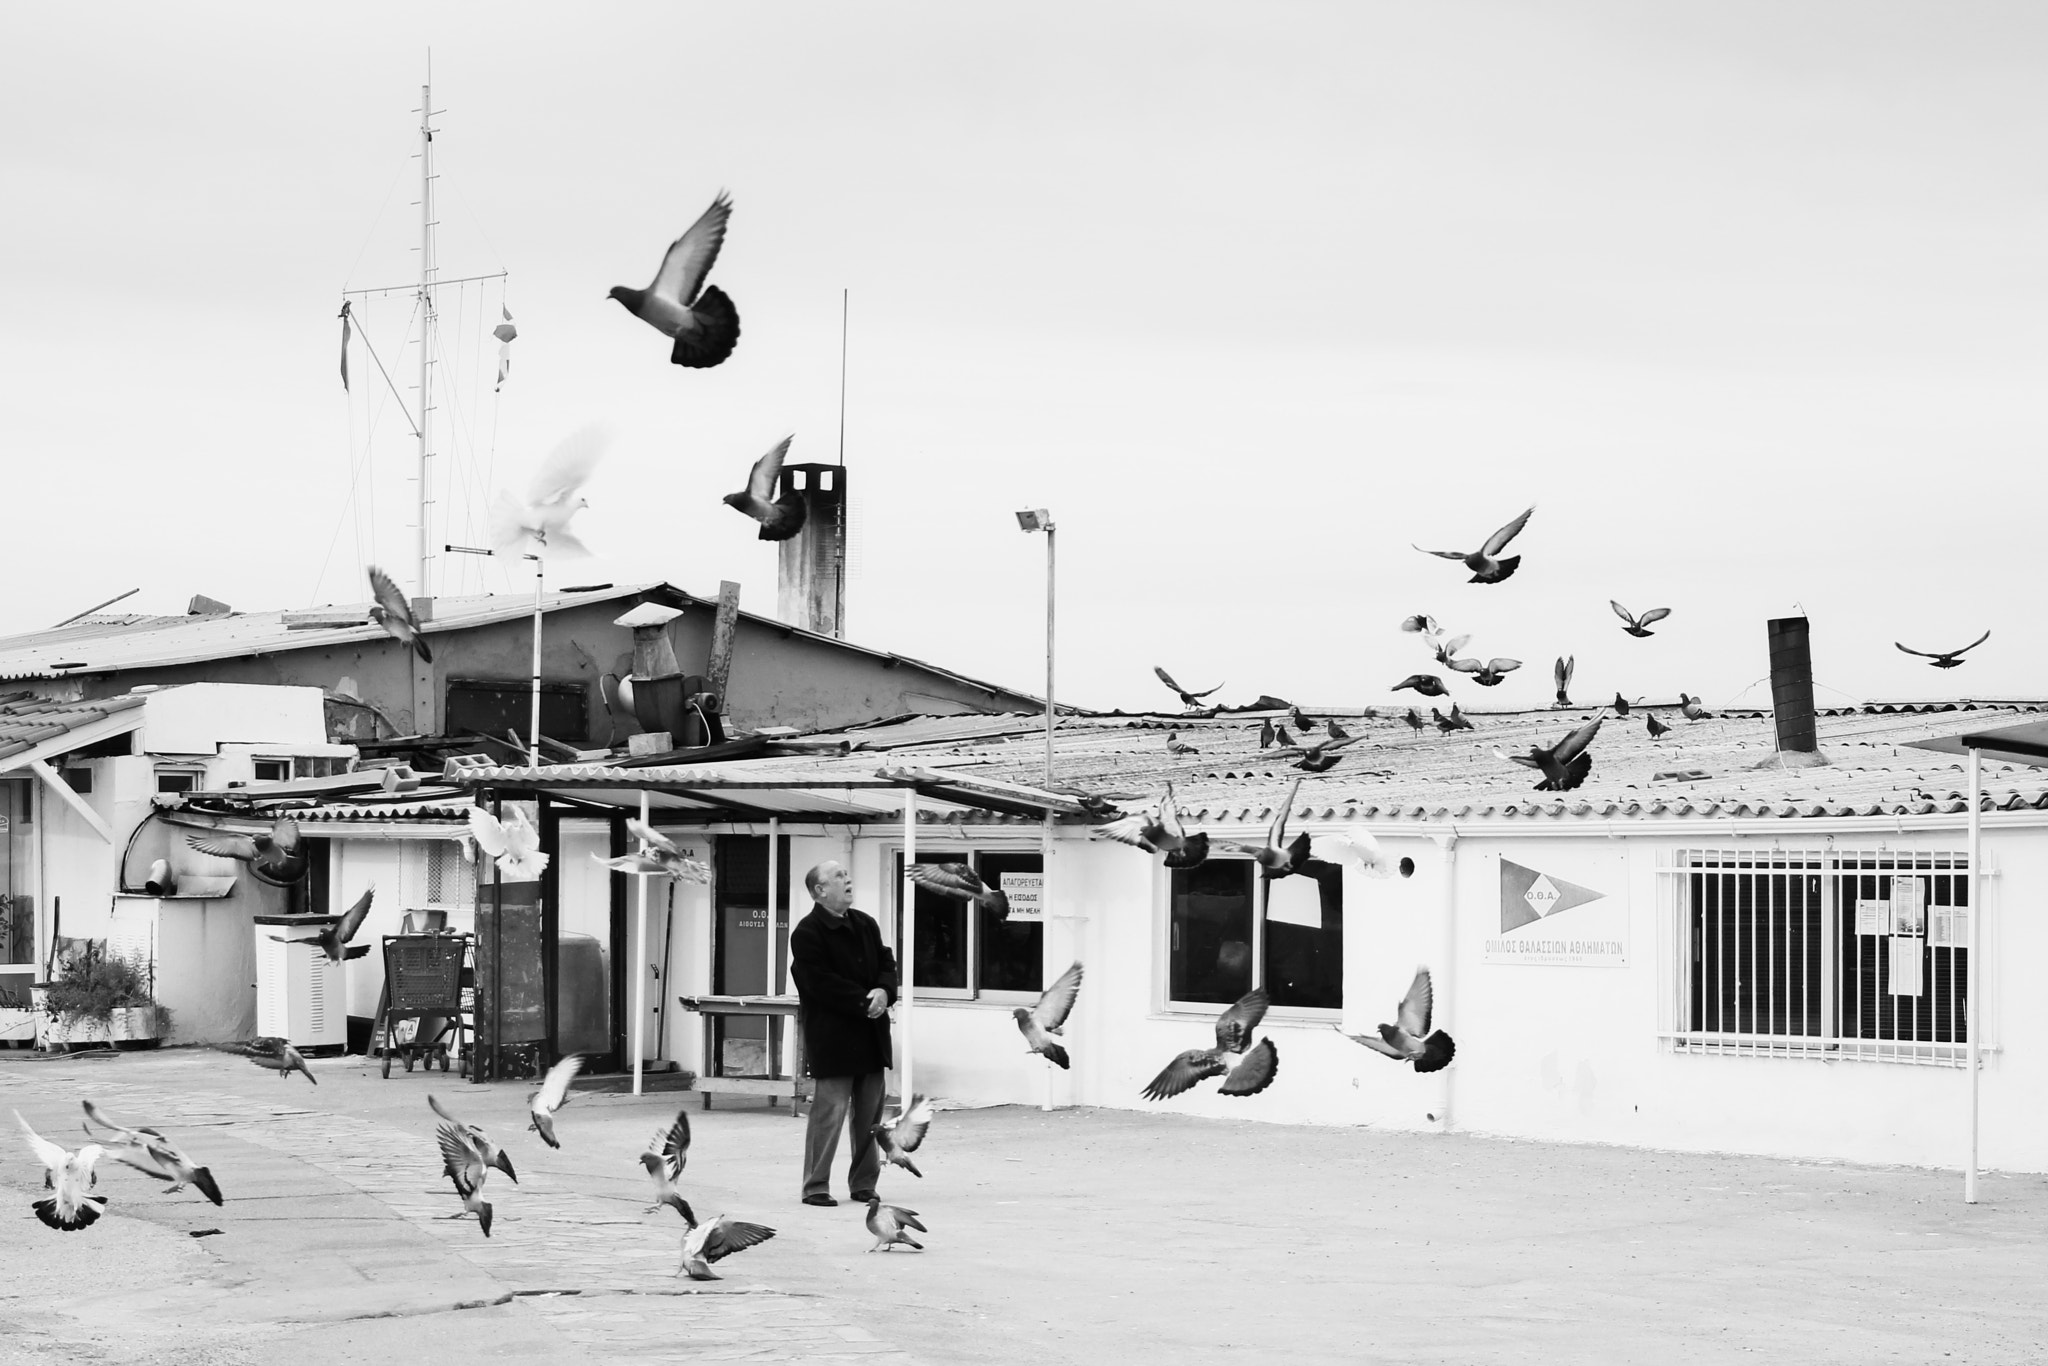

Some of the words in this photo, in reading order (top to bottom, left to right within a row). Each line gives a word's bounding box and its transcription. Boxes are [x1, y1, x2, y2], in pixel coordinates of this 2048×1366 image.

[1014, 893, 1038, 901] ΕΙΣΟΔΟΣ
[1527, 891, 1557, 900] Ο.Θ.Α.
[752, 910, 769, 919] Ο.Θ.
[739, 920, 765, 928] ΑΙΘΟΥΣΑ
[1485, 939, 1517, 953] ΟΜΙΛΟΣ
[1519, 940, 1567, 954] ΘΑΛΑΣΣΙΩΝ
[1569, 940, 1623, 955] ΑΘΛΗΜΑΤΩΝ
